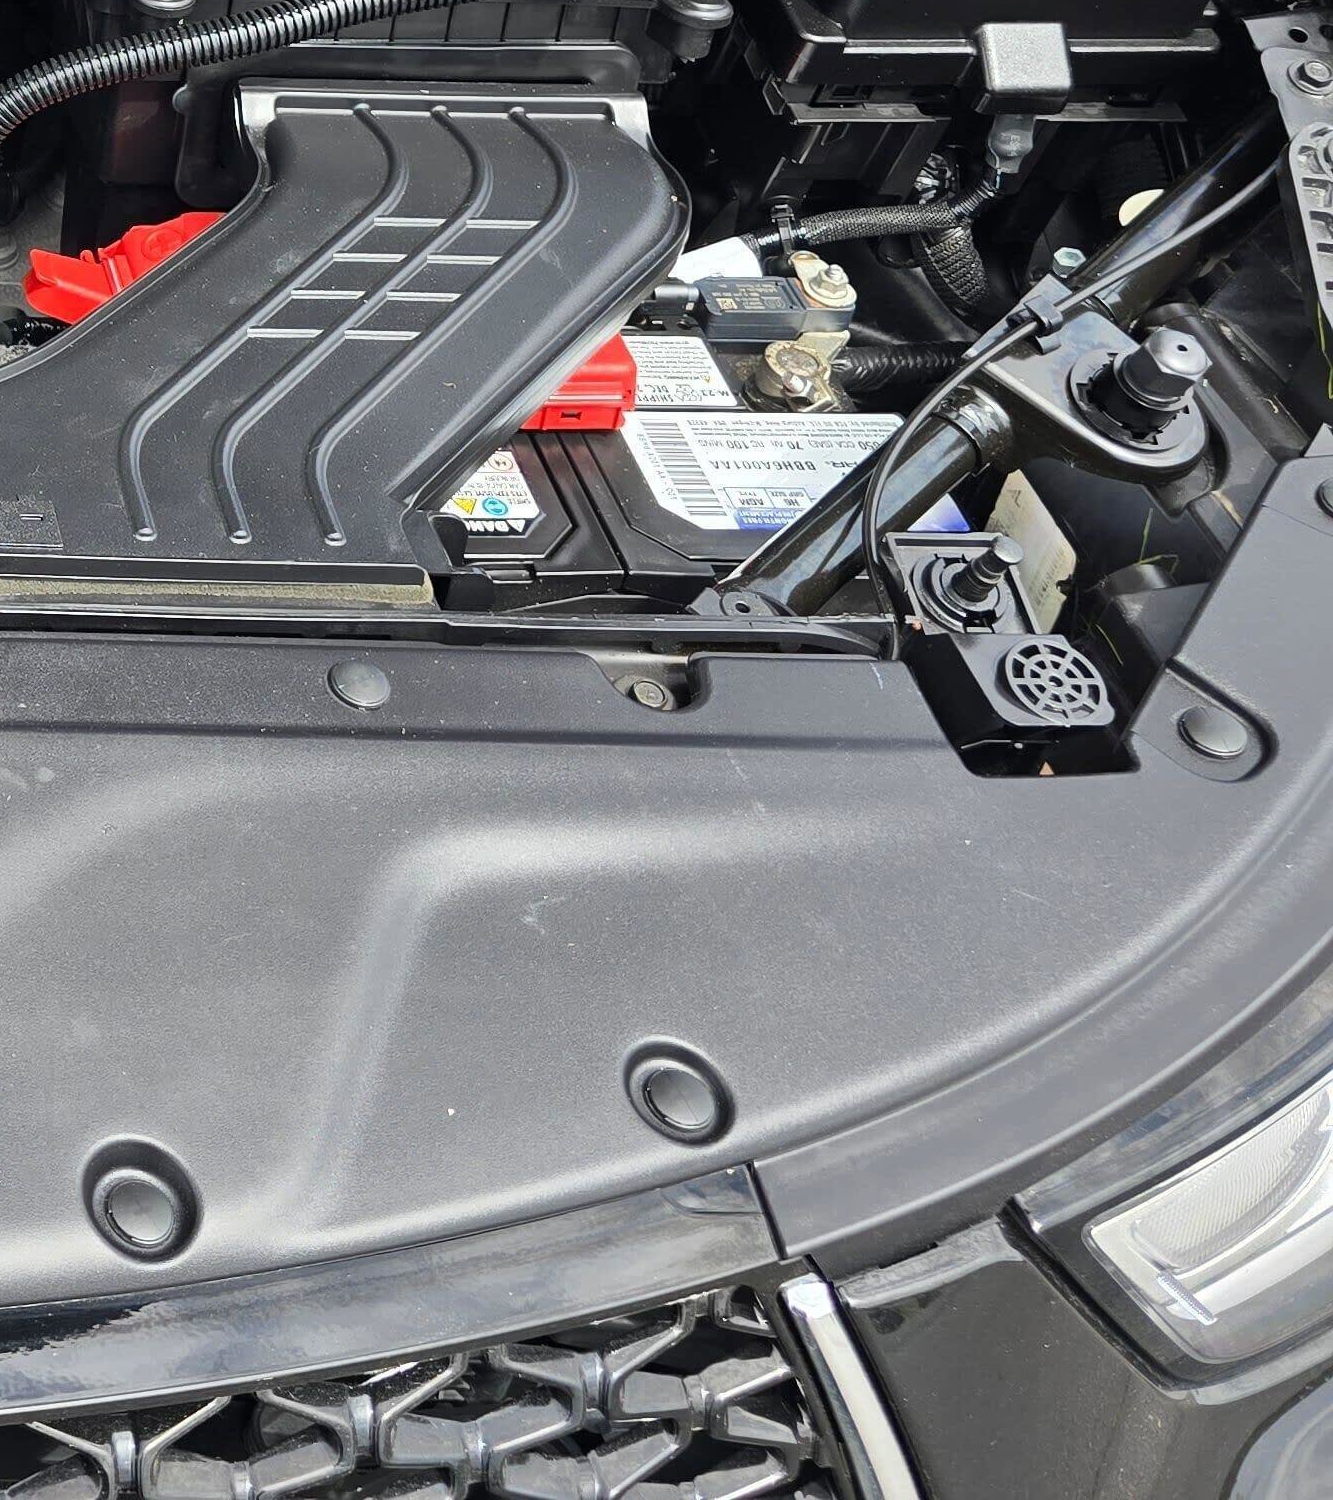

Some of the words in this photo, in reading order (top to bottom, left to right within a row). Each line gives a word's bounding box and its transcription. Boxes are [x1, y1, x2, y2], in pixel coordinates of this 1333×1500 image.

[726, 440, 749, 449] 100
[786, 441, 804, 450] 70
[738, 498, 764, 506] AGM
[465, 520, 509, 532] DAN
